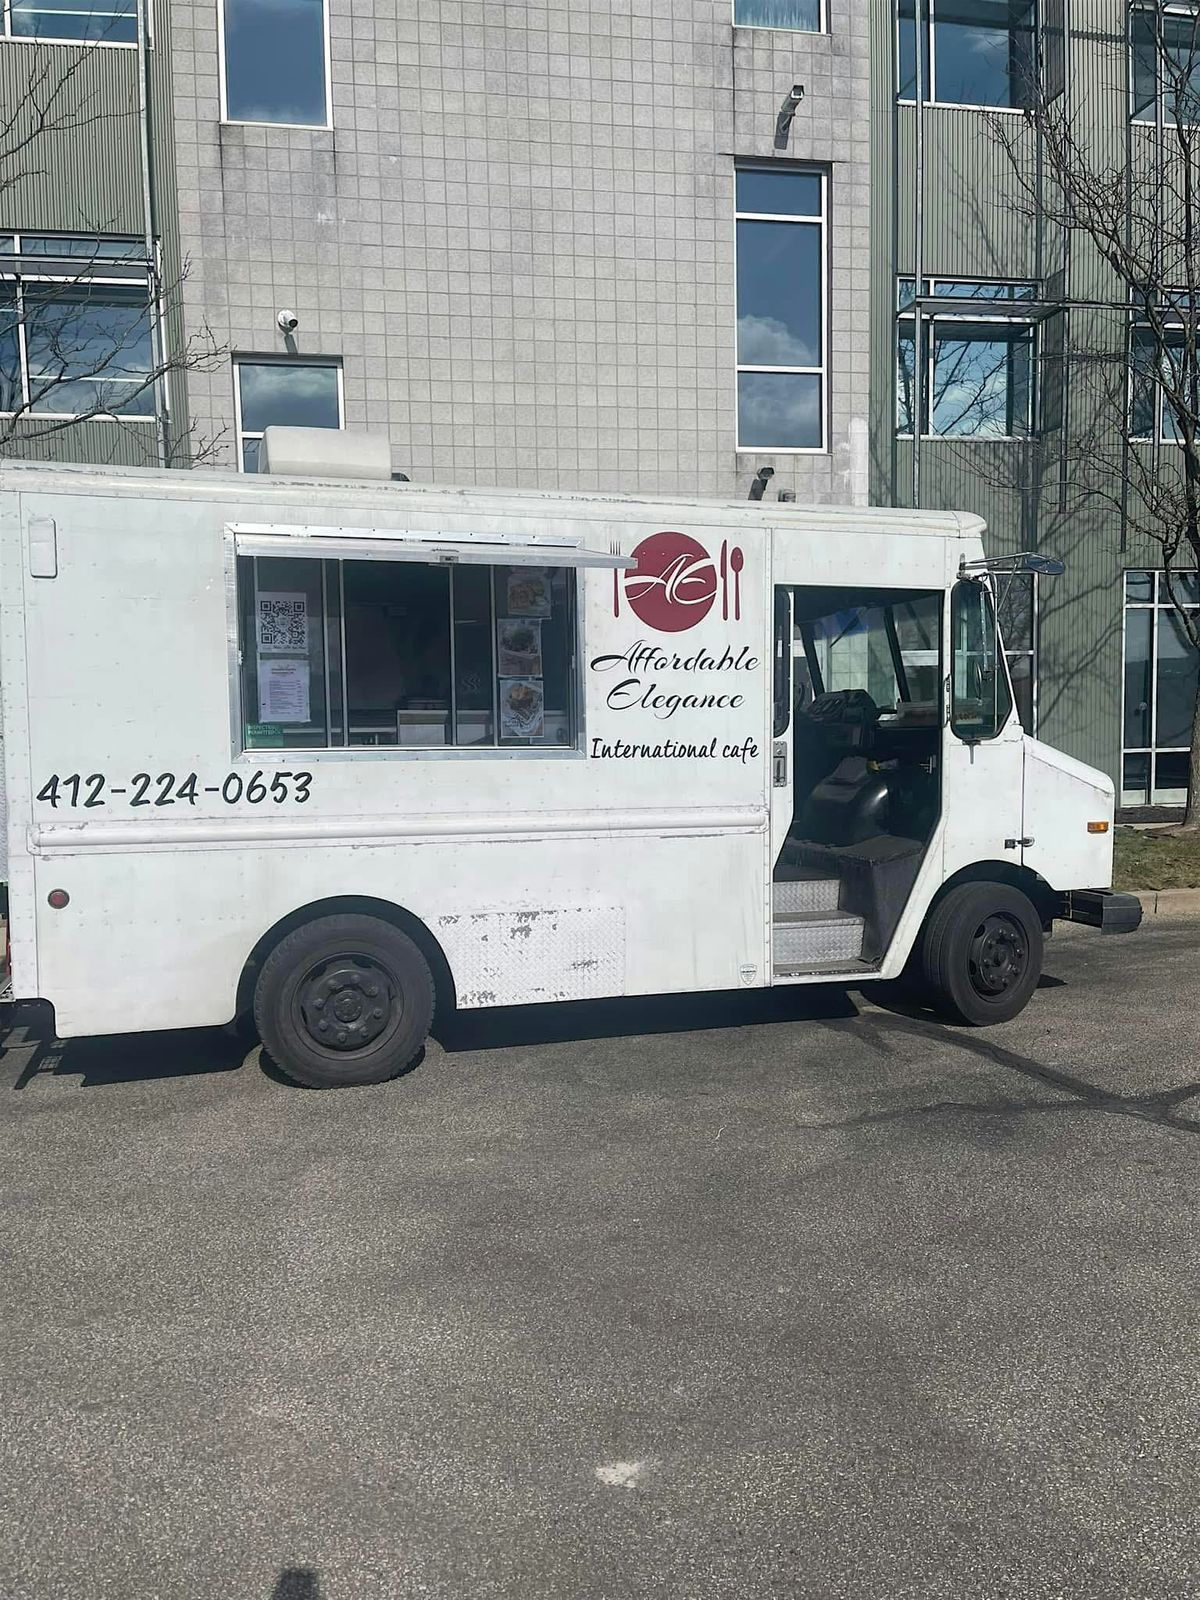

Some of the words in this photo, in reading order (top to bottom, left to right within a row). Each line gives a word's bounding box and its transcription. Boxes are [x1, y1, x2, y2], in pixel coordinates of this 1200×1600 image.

[590, 639, 760, 673] Affordable
[606, 678, 744, 719] Elegance
[590, 737, 717, 758] International
[722, 737, 759, 764] cafe
[36, 770, 312, 808] 412-224-0653
